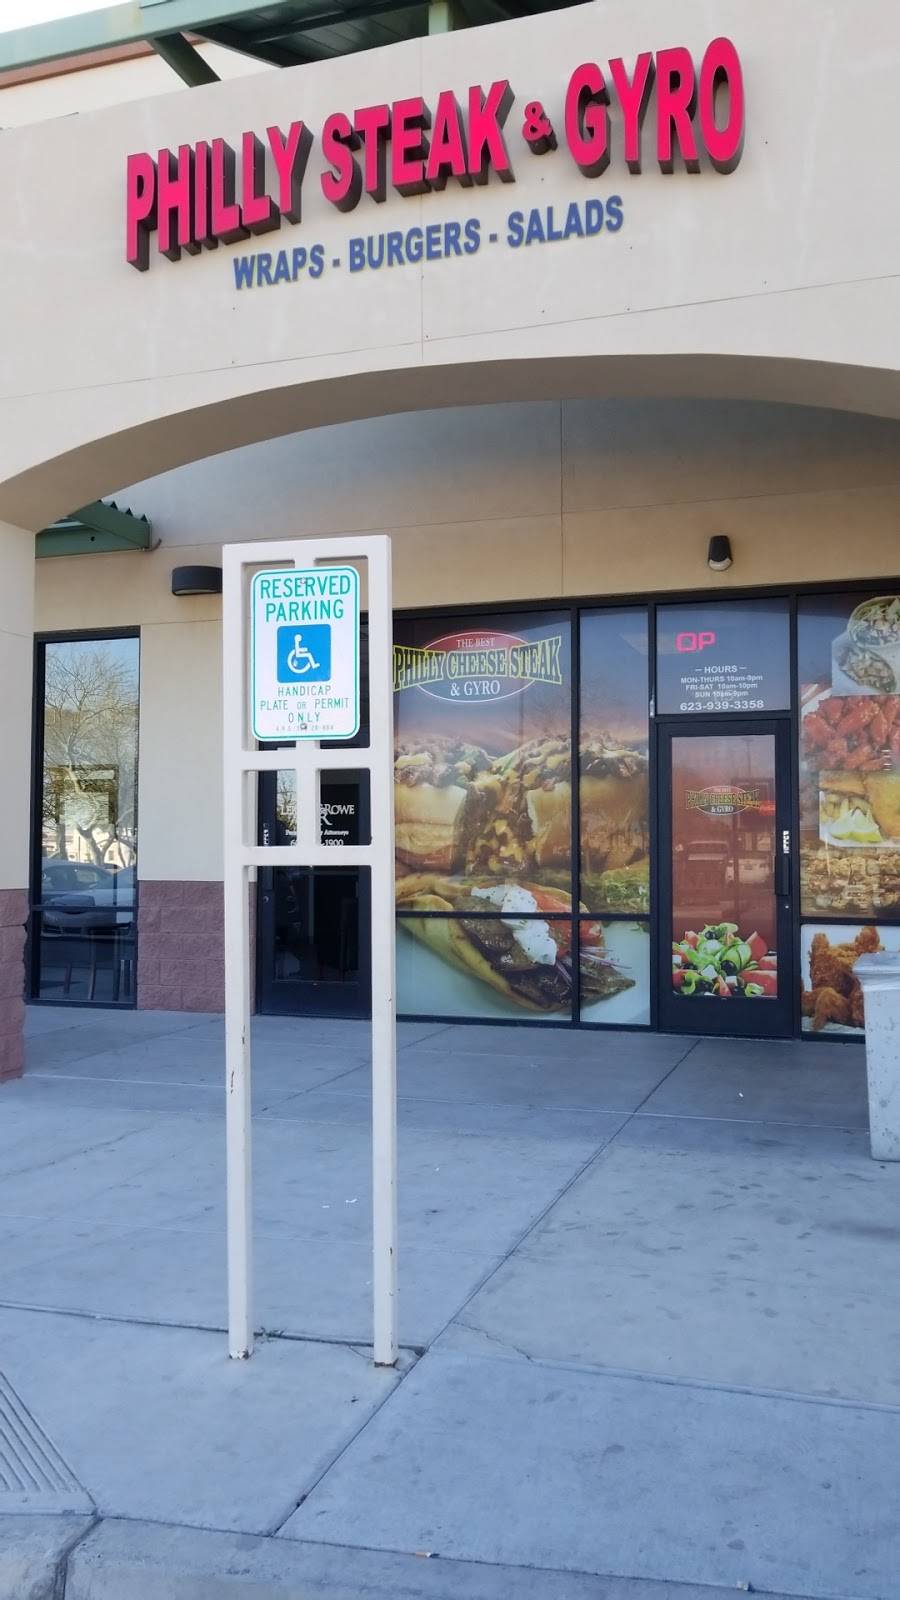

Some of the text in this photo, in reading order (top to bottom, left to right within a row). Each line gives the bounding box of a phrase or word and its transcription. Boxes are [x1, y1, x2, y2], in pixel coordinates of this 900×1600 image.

[126, 36, 745, 267] PHILLY STEAK & GYRO
[233, 245, 325, 290] WRAPS
[348, 218, 482, 273] BURGERS
[507, 195, 624, 248] SALADS
[260, 575, 351, 599] RESERVED
[266, 599, 344, 622] PARKING
[457, 637, 495, 648] THE BEST
[393, 636, 562, 692] PHILLY CHEESE STEAK
[704, 665, 737, 673] HOURS
[680, 676, 725, 684] MON-THURS
[278, 685, 331, 697] HANDICAP
[450, 680, 500, 696] & GYRO
[685, 684, 714, 692] FRI-SAT
[695, 691, 711, 699] SUN
[260, 700, 288, 711] PLATE
[314, 698, 349, 709] PERMIT
[680, 700, 764, 711] 623-939-3358
[288, 712, 321, 723] ONLY
[324, 804, 355, 815] ROWE
